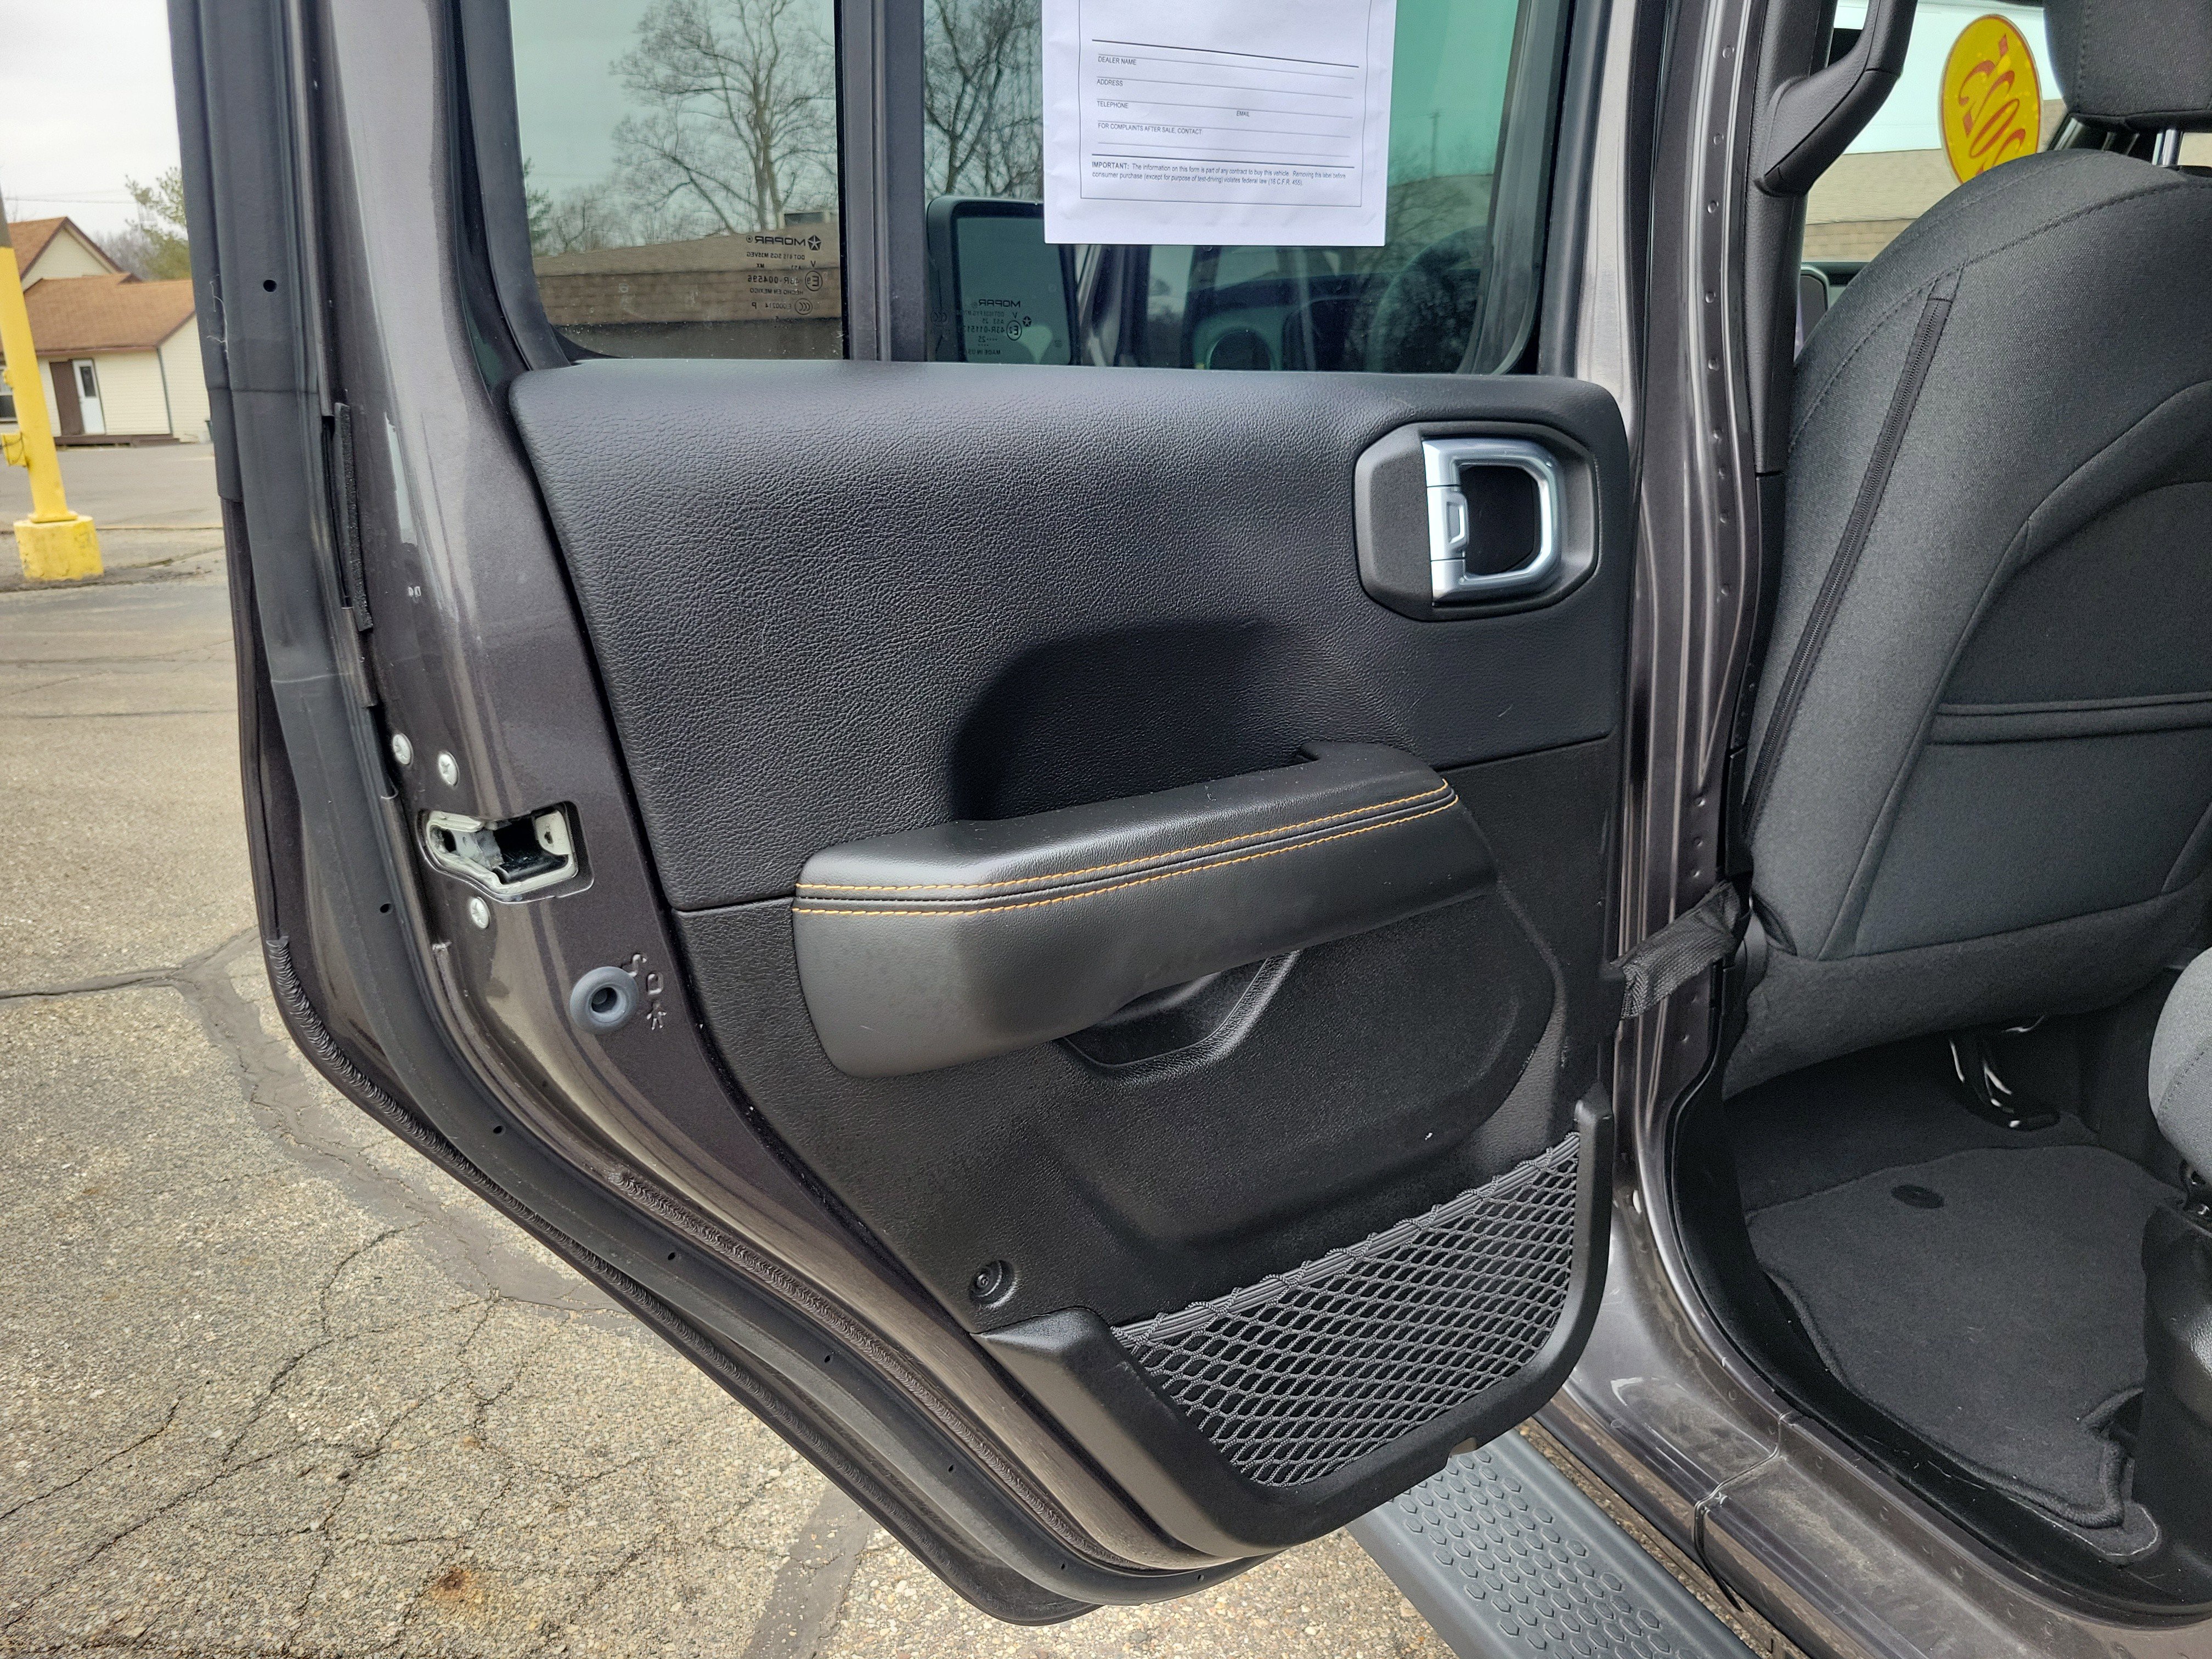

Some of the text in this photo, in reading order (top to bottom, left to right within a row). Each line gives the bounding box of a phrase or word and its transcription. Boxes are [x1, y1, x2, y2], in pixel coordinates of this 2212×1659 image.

[1098, 56, 1120, 65] DEALER
[1097, 101, 1128, 109] TELEPHONE
[1110, 123, 1144, 132] COMPLAINTS
[1092, 161, 1129, 170] IMPORTANT:
[1293, 171, 1314, 179] Removing
[1198, 176, 1223, 184] test-driving)
